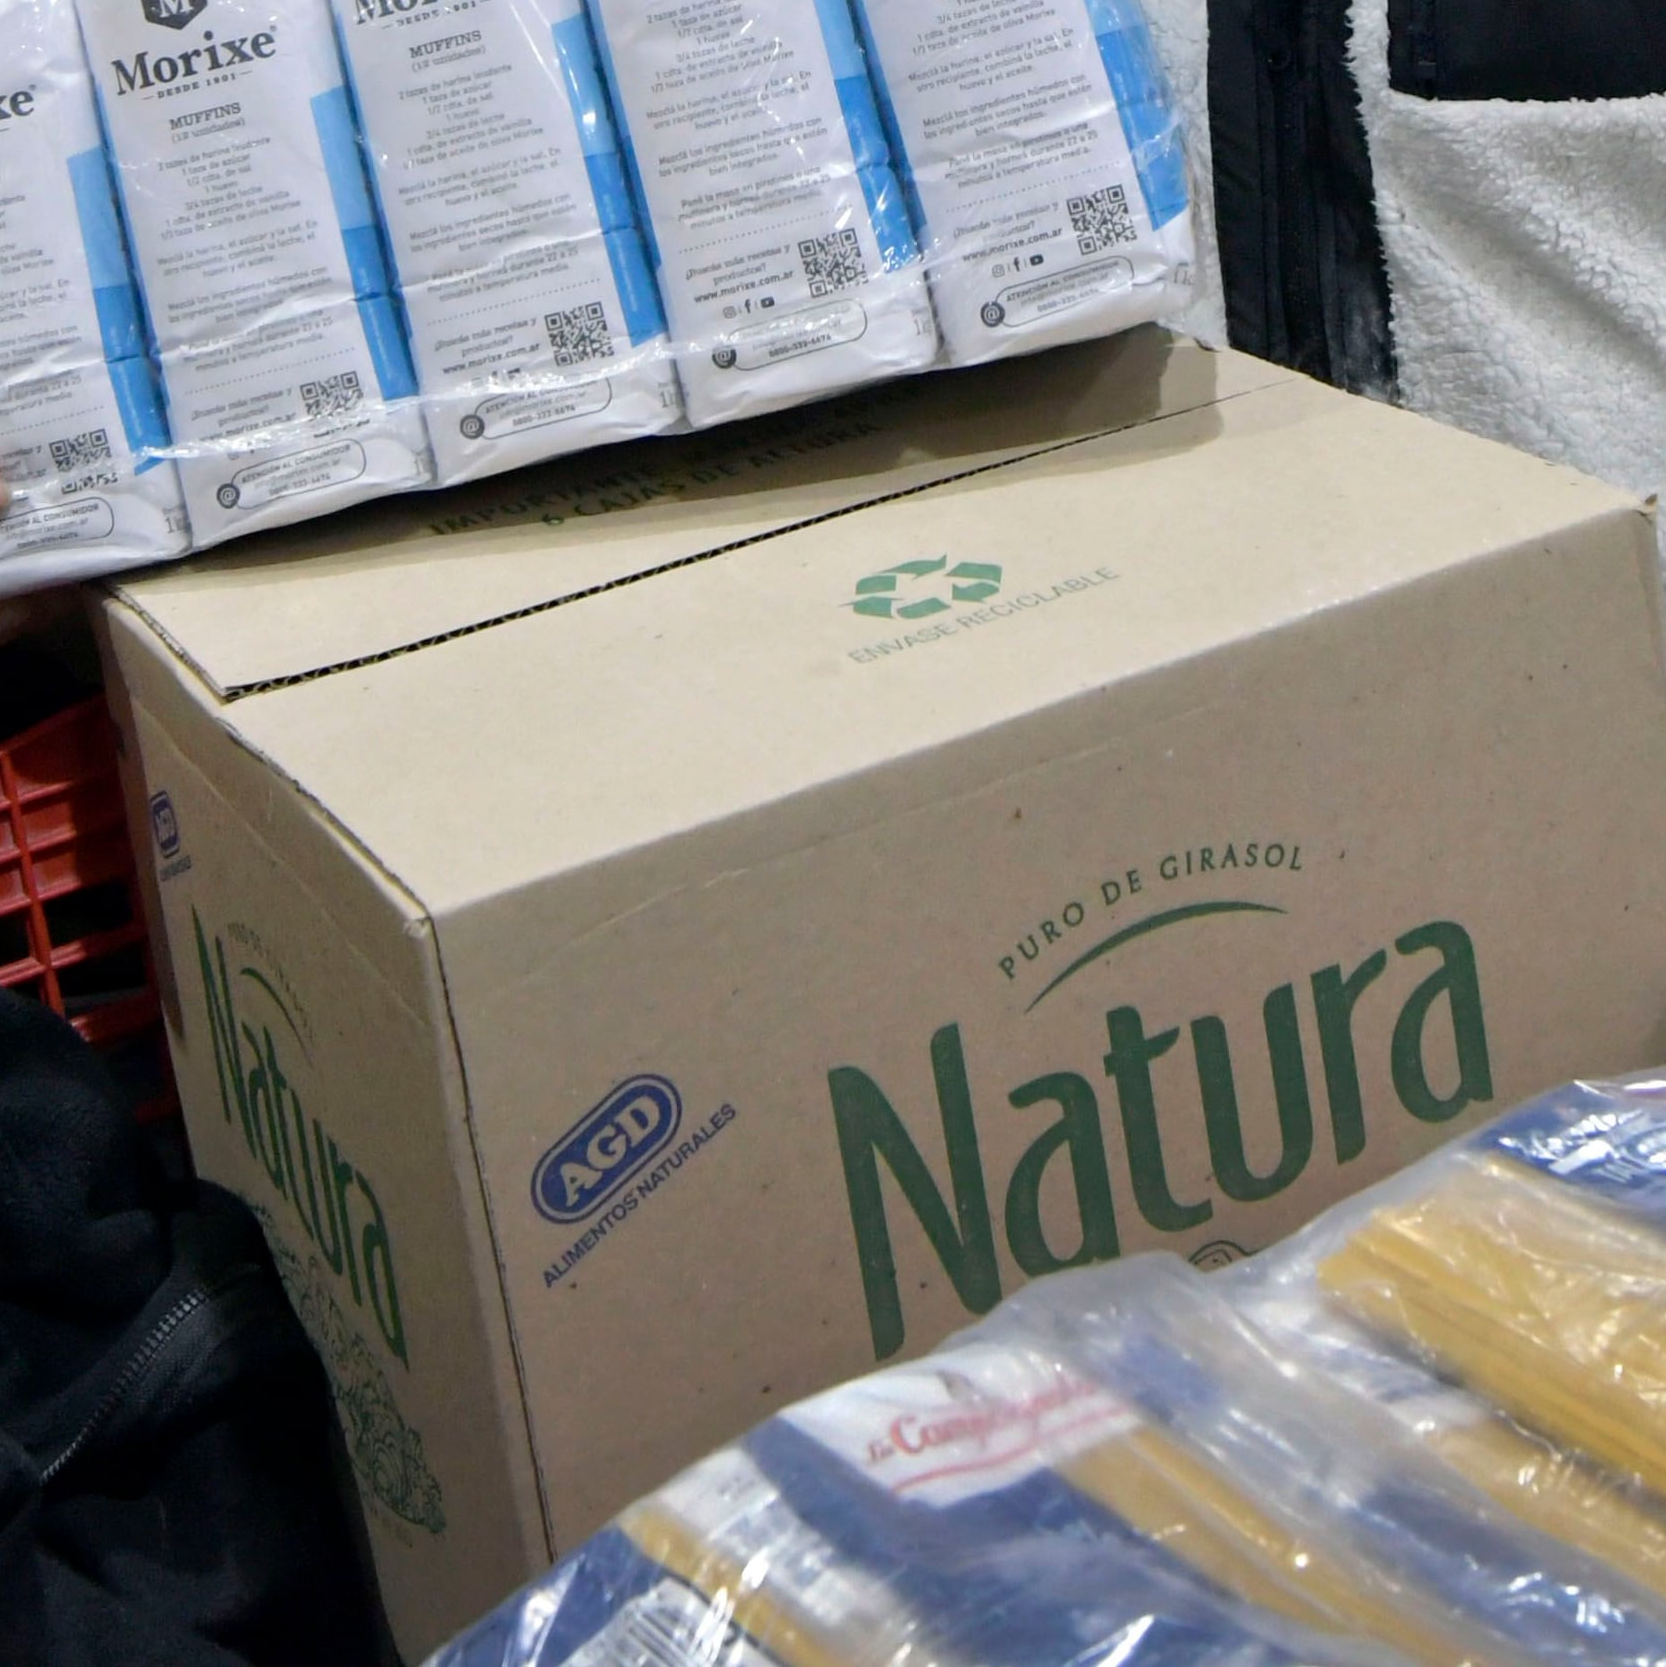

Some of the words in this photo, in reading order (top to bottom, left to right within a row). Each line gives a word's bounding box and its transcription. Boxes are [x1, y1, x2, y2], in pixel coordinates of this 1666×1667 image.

[110, 23, 276, 94] Morixe
[156, 81, 200, 98] DESDE
[205, 72, 237, 86] 1901
[408, 29, 483, 58] MUFFINS
[168, 102, 242, 130] MUFFINS
[692, 270, 795, 303] www.morixe.com.ar
[440, 343, 542, 375] www.morixe.com.ar
[848, 622, 959, 664] ENVASE
[955, 565, 1121, 629] RECICLABLE
[997, 900, 1088, 980] PURO
[1101, 869, 1144, 907] DE
[1159, 842, 1305, 881] GIRASOL
[191, 901, 410, 1373] Natura
[560, 1095, 661, 1207] AGD
[827, 919, 1495, 1362] Natura
[542, 1192, 639, 1289] ALIMENTOS
[636, 1102, 737, 1199] NATURALES
